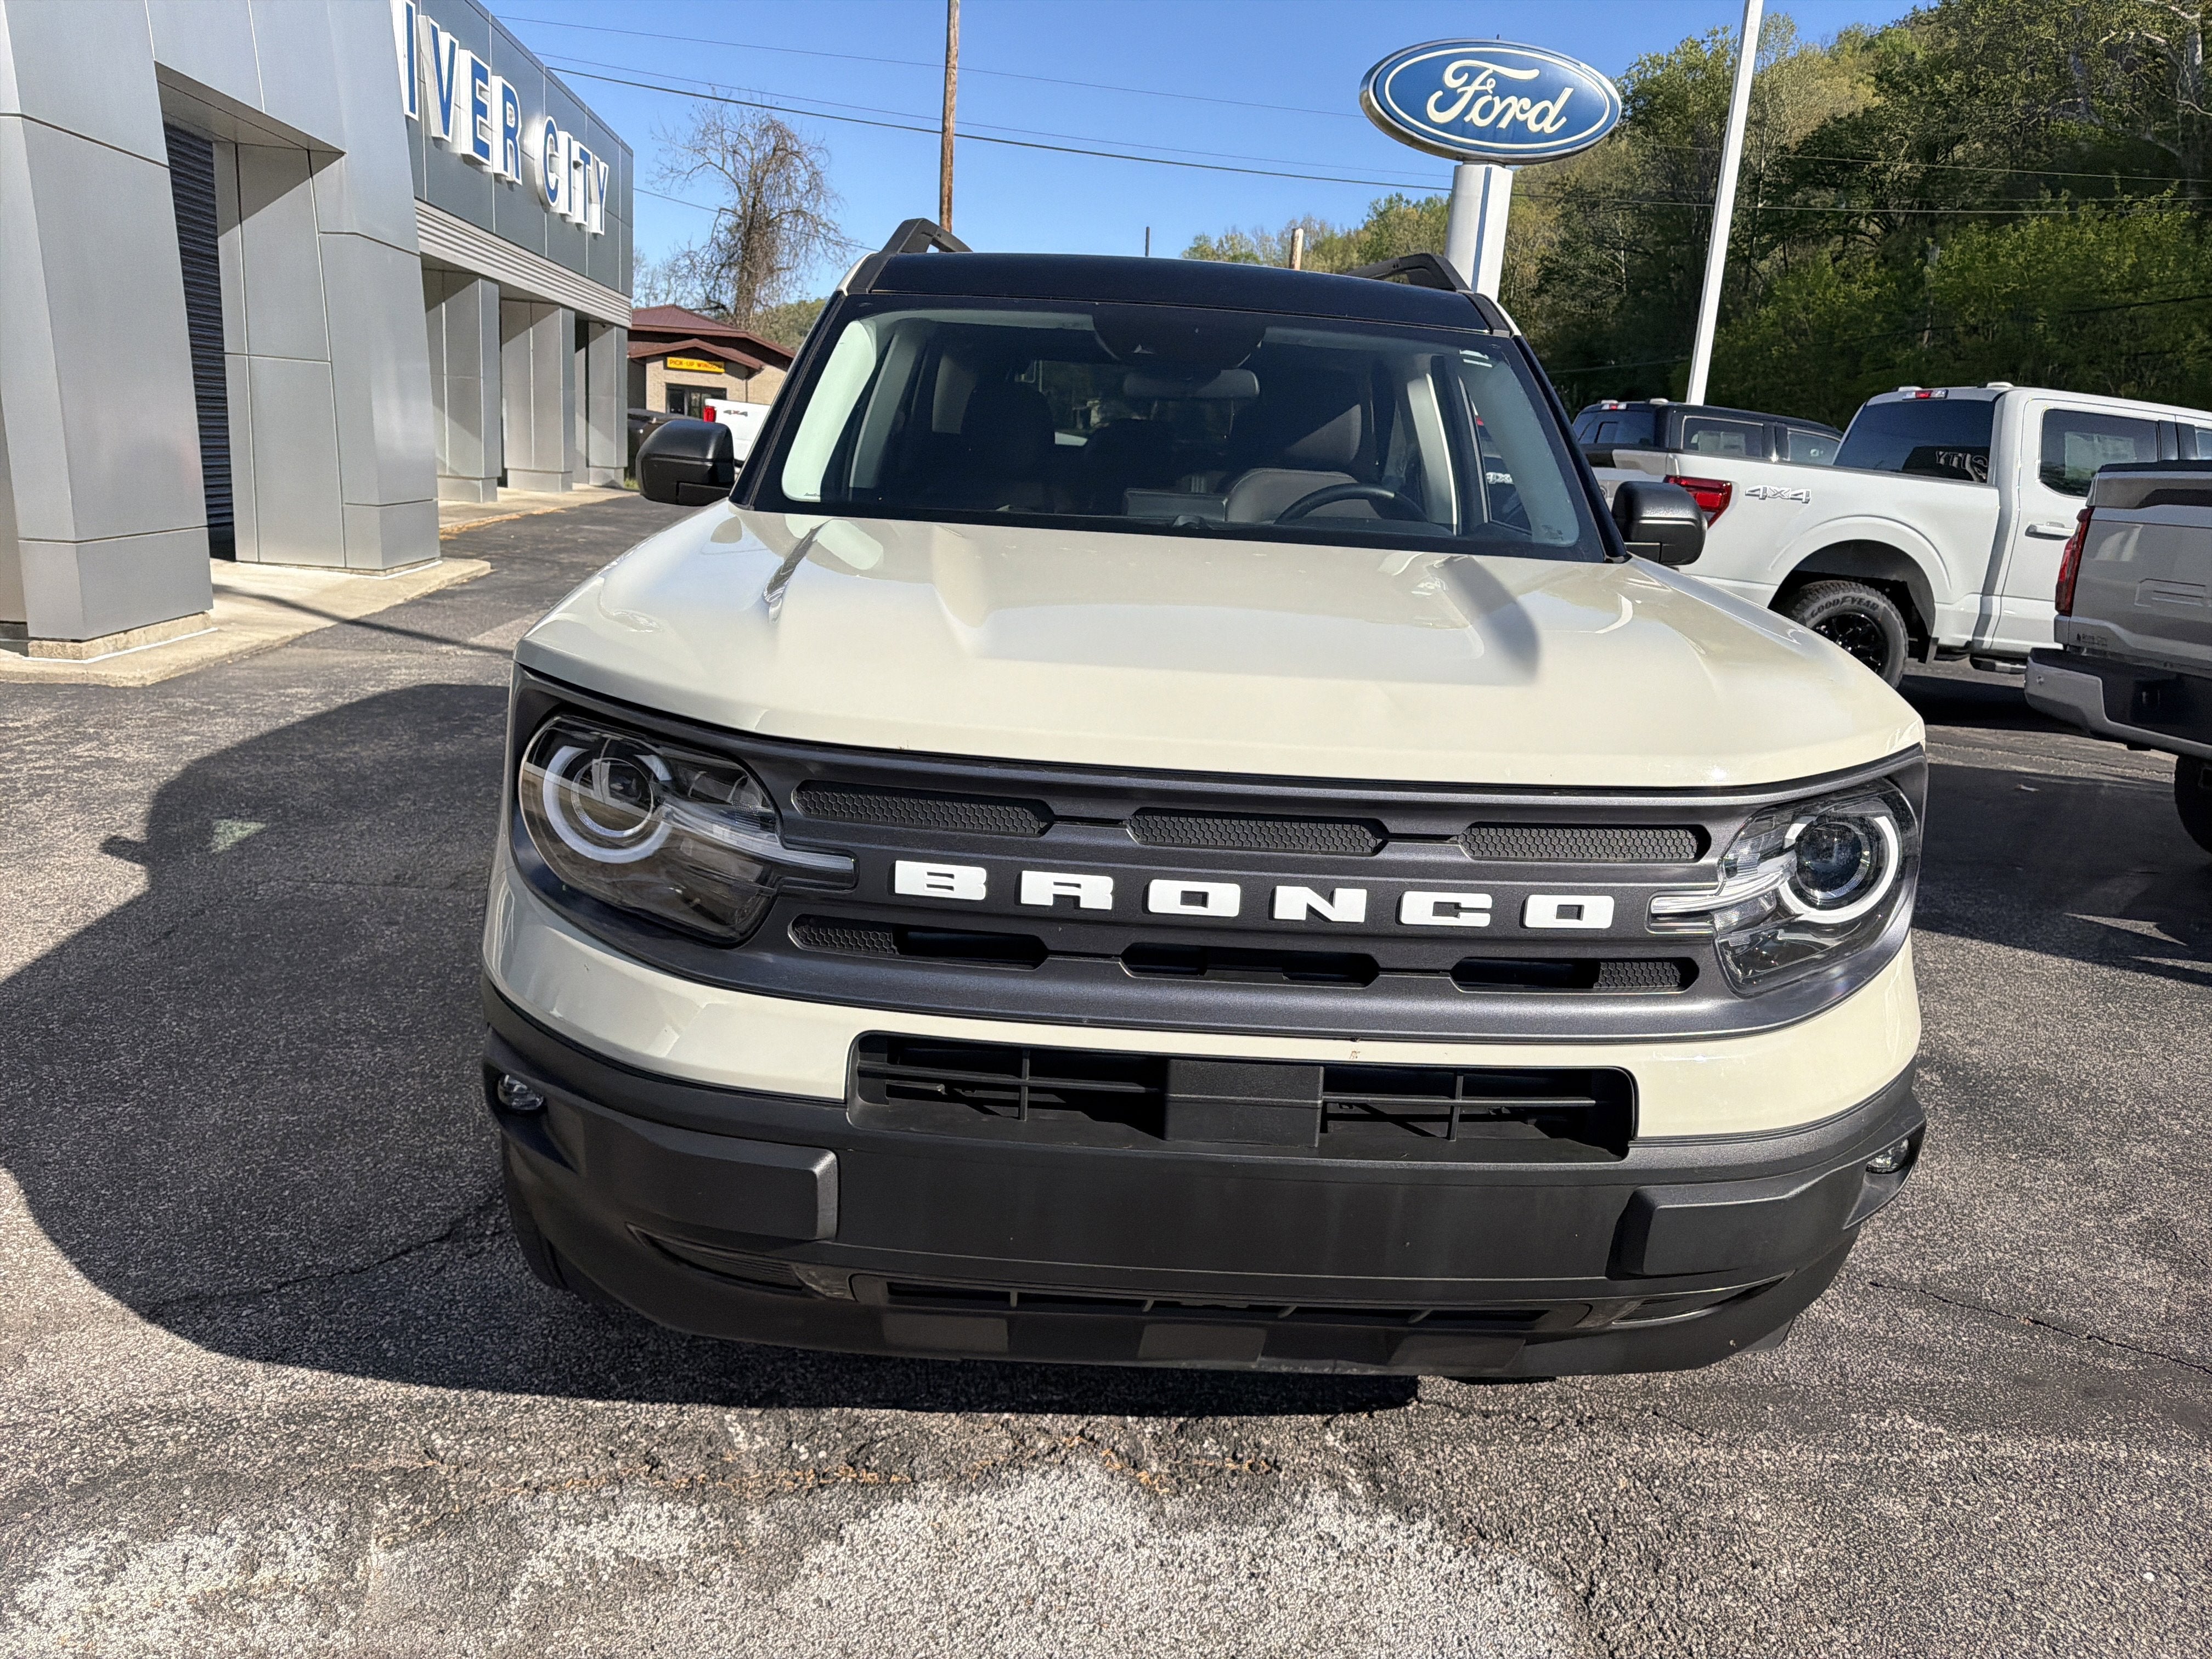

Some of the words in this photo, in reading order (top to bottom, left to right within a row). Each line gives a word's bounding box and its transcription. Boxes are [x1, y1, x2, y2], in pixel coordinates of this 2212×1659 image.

[1426, 59, 1575, 134] Ford
[535, 115, 608, 235] CITY
[1810, 595, 1880, 618] GOODYEAR
[894, 860, 1615, 929] BRONCO
